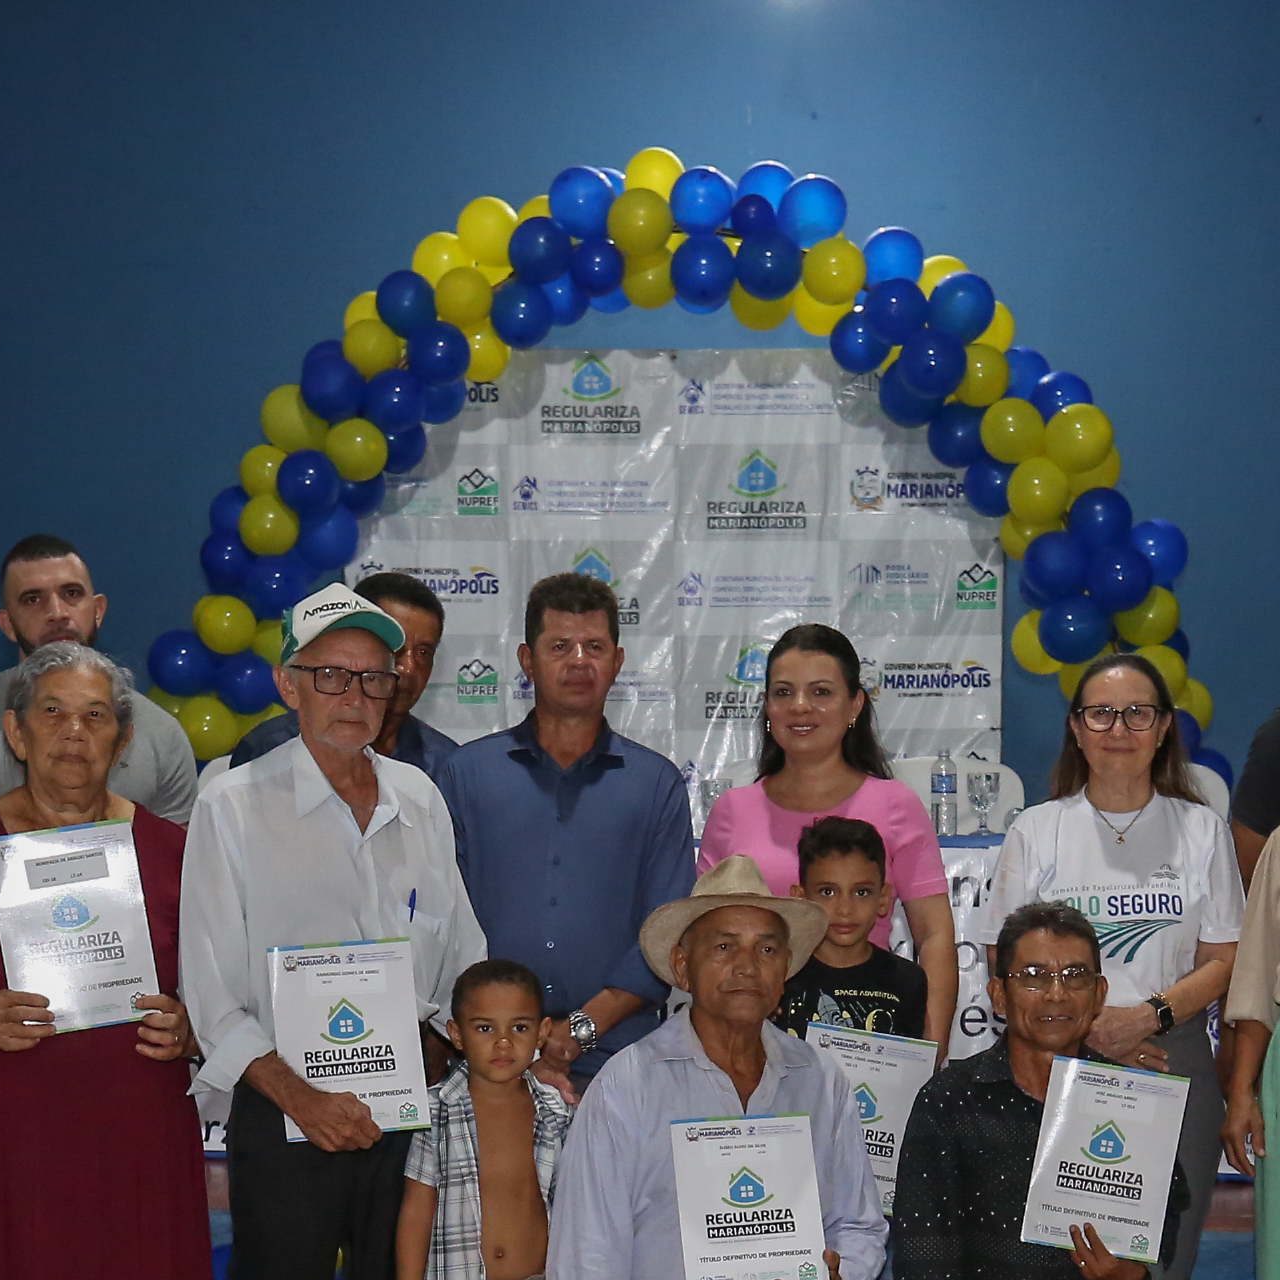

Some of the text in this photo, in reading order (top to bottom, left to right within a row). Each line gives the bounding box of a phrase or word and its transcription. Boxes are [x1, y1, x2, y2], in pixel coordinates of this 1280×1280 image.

[542, 405, 640, 419] REGULARIZA
[542, 421, 640, 433] MARIANÓPOLIS
[887, 480, 965, 499] MARIANÓP
[457, 497, 498, 507] NUPREF
[707, 501, 806, 514] REGULARIZA
[707, 516, 806, 529] MARIANÓPOLIS
[956, 591, 997, 601] NUPREF
[303, 601, 351, 621] Amazon
[917, 662, 953, 670] MUNICIPAL
[884, 669, 991, 689] MARIANÓPOLIS
[457, 685, 499, 695] NUPREF
[85, 851, 103, 859] SANTOS
[1052, 886, 1079, 896] Semana
[1093, 883, 1144, 892] Regularização
[1147, 882, 1181, 891] Fundiária
[1065, 893, 1183, 917] OLO SEGURO
[297, 956, 341, 967] MARIANÓPOLIS
[98, 976, 143, 989] PROPRIEDADE
[304, 1045, 394, 1064] REGULARIZA
[307, 1060, 395, 1078] MARIANÓPOLIS
[1078, 1075, 1120, 1087] MARIANÓPOLIS
[369, 1088, 412, 1099] PROPRIEDADE
[699, 1128, 742, 1137] MARIANÓPOLIS
[1059, 1161, 1143, 1187] REGULARIZA
[1057, 1175, 1141, 1199] MARIANÓPOLIS
[705, 1208, 794, 1226] REGULARIZA
[1041, 1203, 1150, 1228] TÍTULO DEFINITIVO DE PROPRIEDADE
[708, 1222, 794, 1238] MARIANÓPOLIS
[722, 1254, 758, 1262] DEFINITIVO
[768, 1249, 812, 1258] PROPRIEDADE
